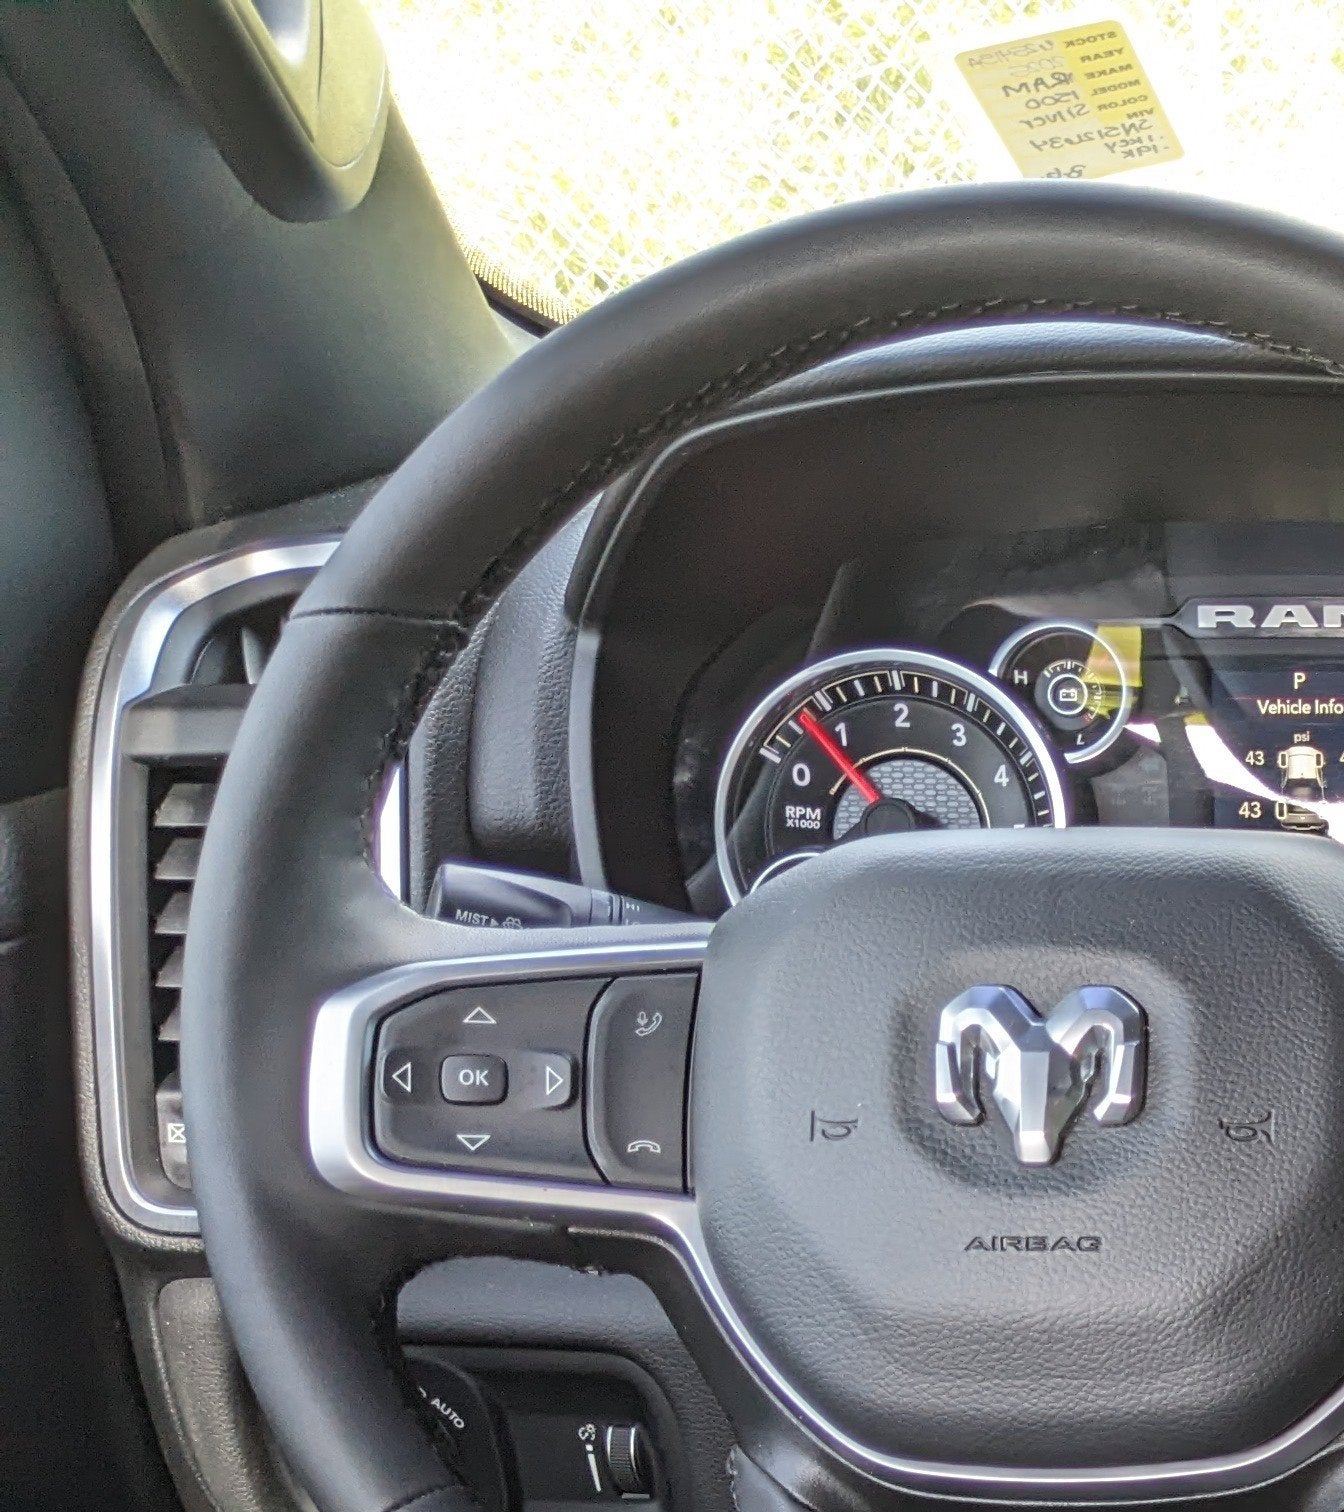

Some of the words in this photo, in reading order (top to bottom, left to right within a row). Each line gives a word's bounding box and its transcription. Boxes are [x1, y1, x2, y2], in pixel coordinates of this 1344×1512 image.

[1014, 670, 1028, 684] H
[1293, 672, 1306, 689] P
[1257, 699, 1311, 715] Vehicle
[1315, 698, 1344, 715] Info
[893, 703, 911, 728] 2
[834, 722, 848, 746] 1
[951, 723, 967, 746] 3
[1077, 734, 1085, 745] L
[1294, 731, 1310, 743] psi
[1245, 750, 1265, 766] 43
[792, 763, 811, 787] 0
[994, 764, 1009, 787] 4
[785, 805, 821, 821] RPM
[1238, 801, 1262, 819] 43
[786, 819, 820, 830] X1000
[455, 909, 490, 925] MIST
[459, 1068, 489, 1087] OK
[963, 1235, 1104, 1253] AIRBAG
[431, 1398, 465, 1429] AUTO
